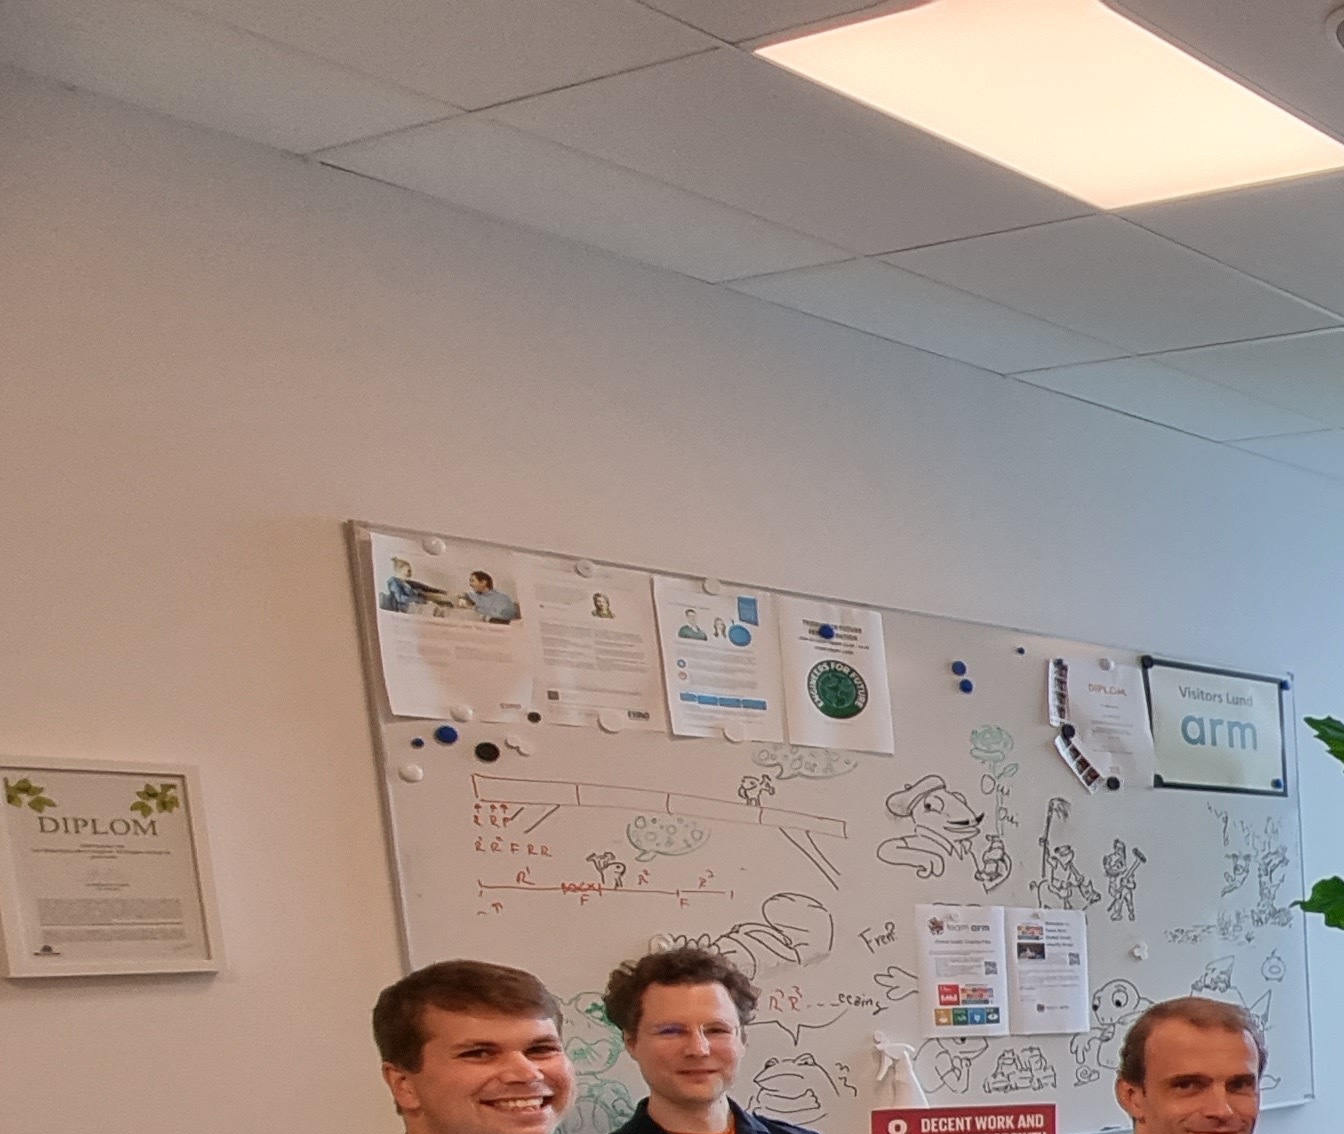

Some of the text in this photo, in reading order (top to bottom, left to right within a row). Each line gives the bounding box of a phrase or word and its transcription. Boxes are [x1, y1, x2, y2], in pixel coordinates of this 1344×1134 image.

[830, 661, 851, 674] FOR
[1179, 685, 1254, 707] Visitors Lund
[1181, 714, 1258, 750] arm
[37, 815, 159, 836] DIPLOM
[920, 1113, 1044, 1133] DECENT WORK AND
